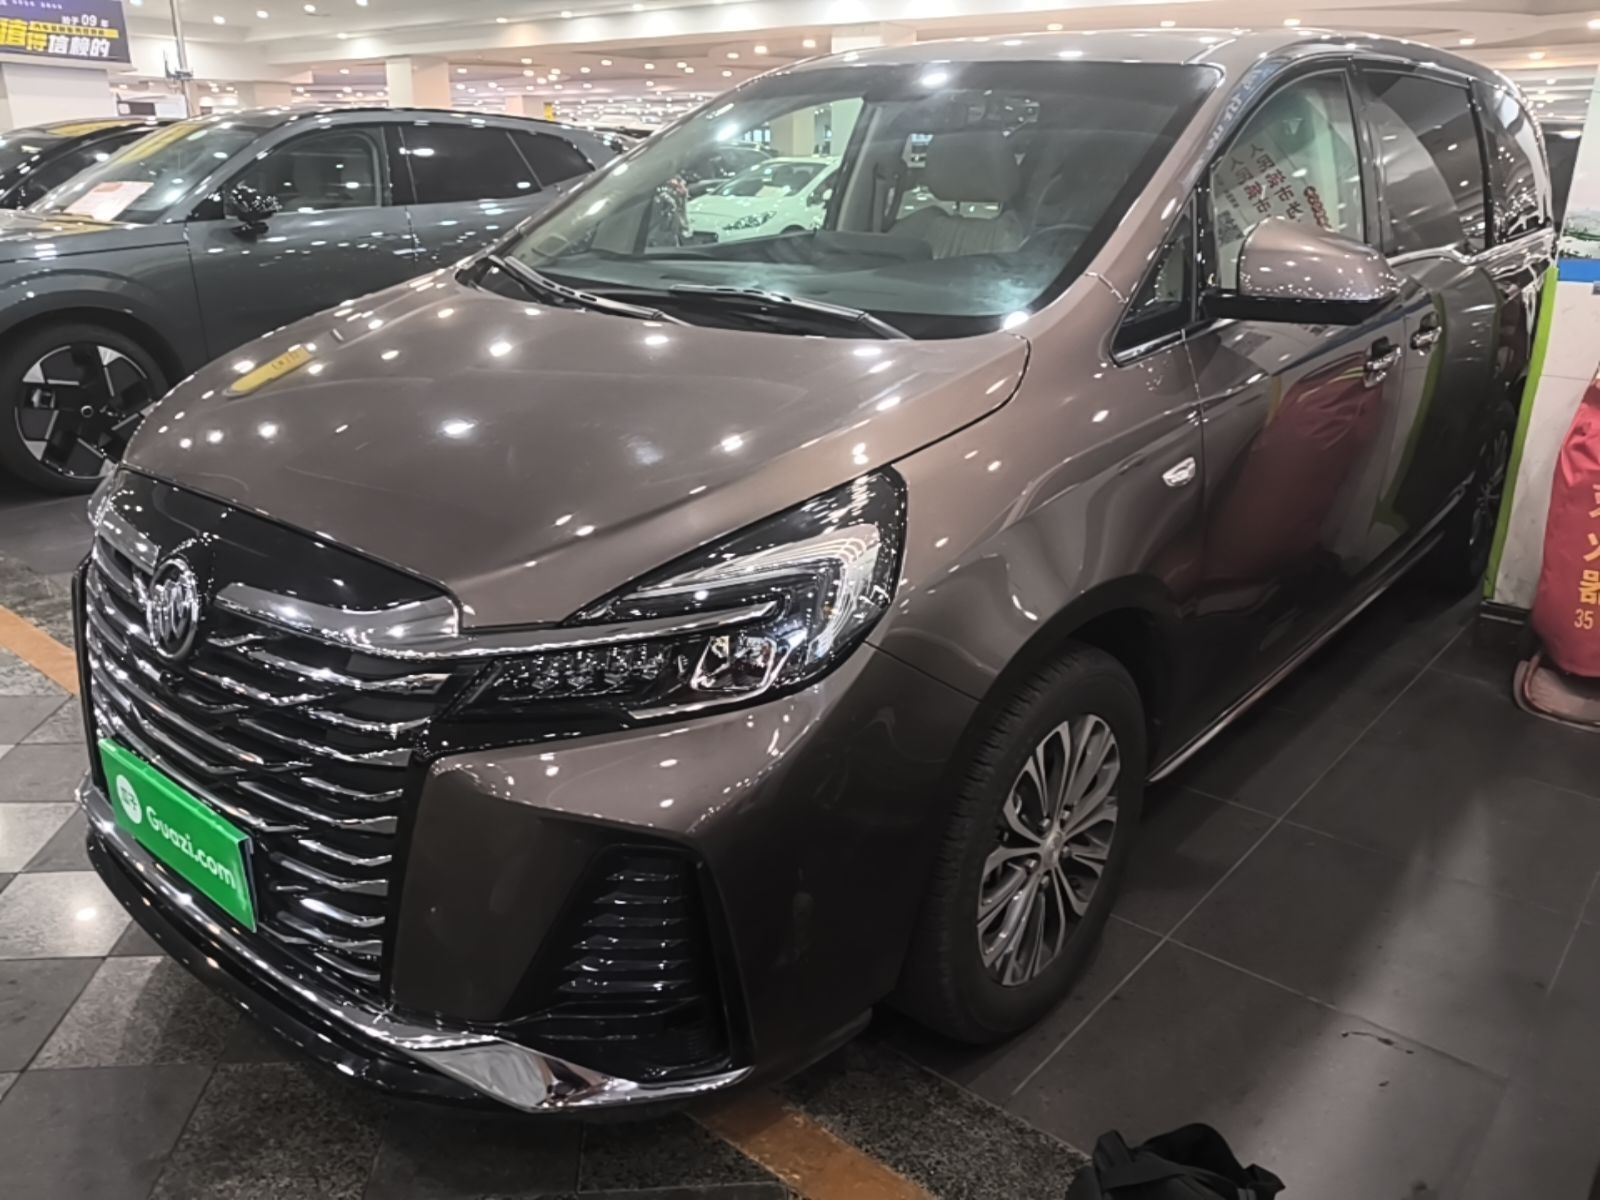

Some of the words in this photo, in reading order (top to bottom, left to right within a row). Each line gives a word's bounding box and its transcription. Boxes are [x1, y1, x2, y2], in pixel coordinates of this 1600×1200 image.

[81, 14, 97, 27] 09
[1574, 609, 1594, 630] 35
[146, 805, 237, 890] Guazi.com
